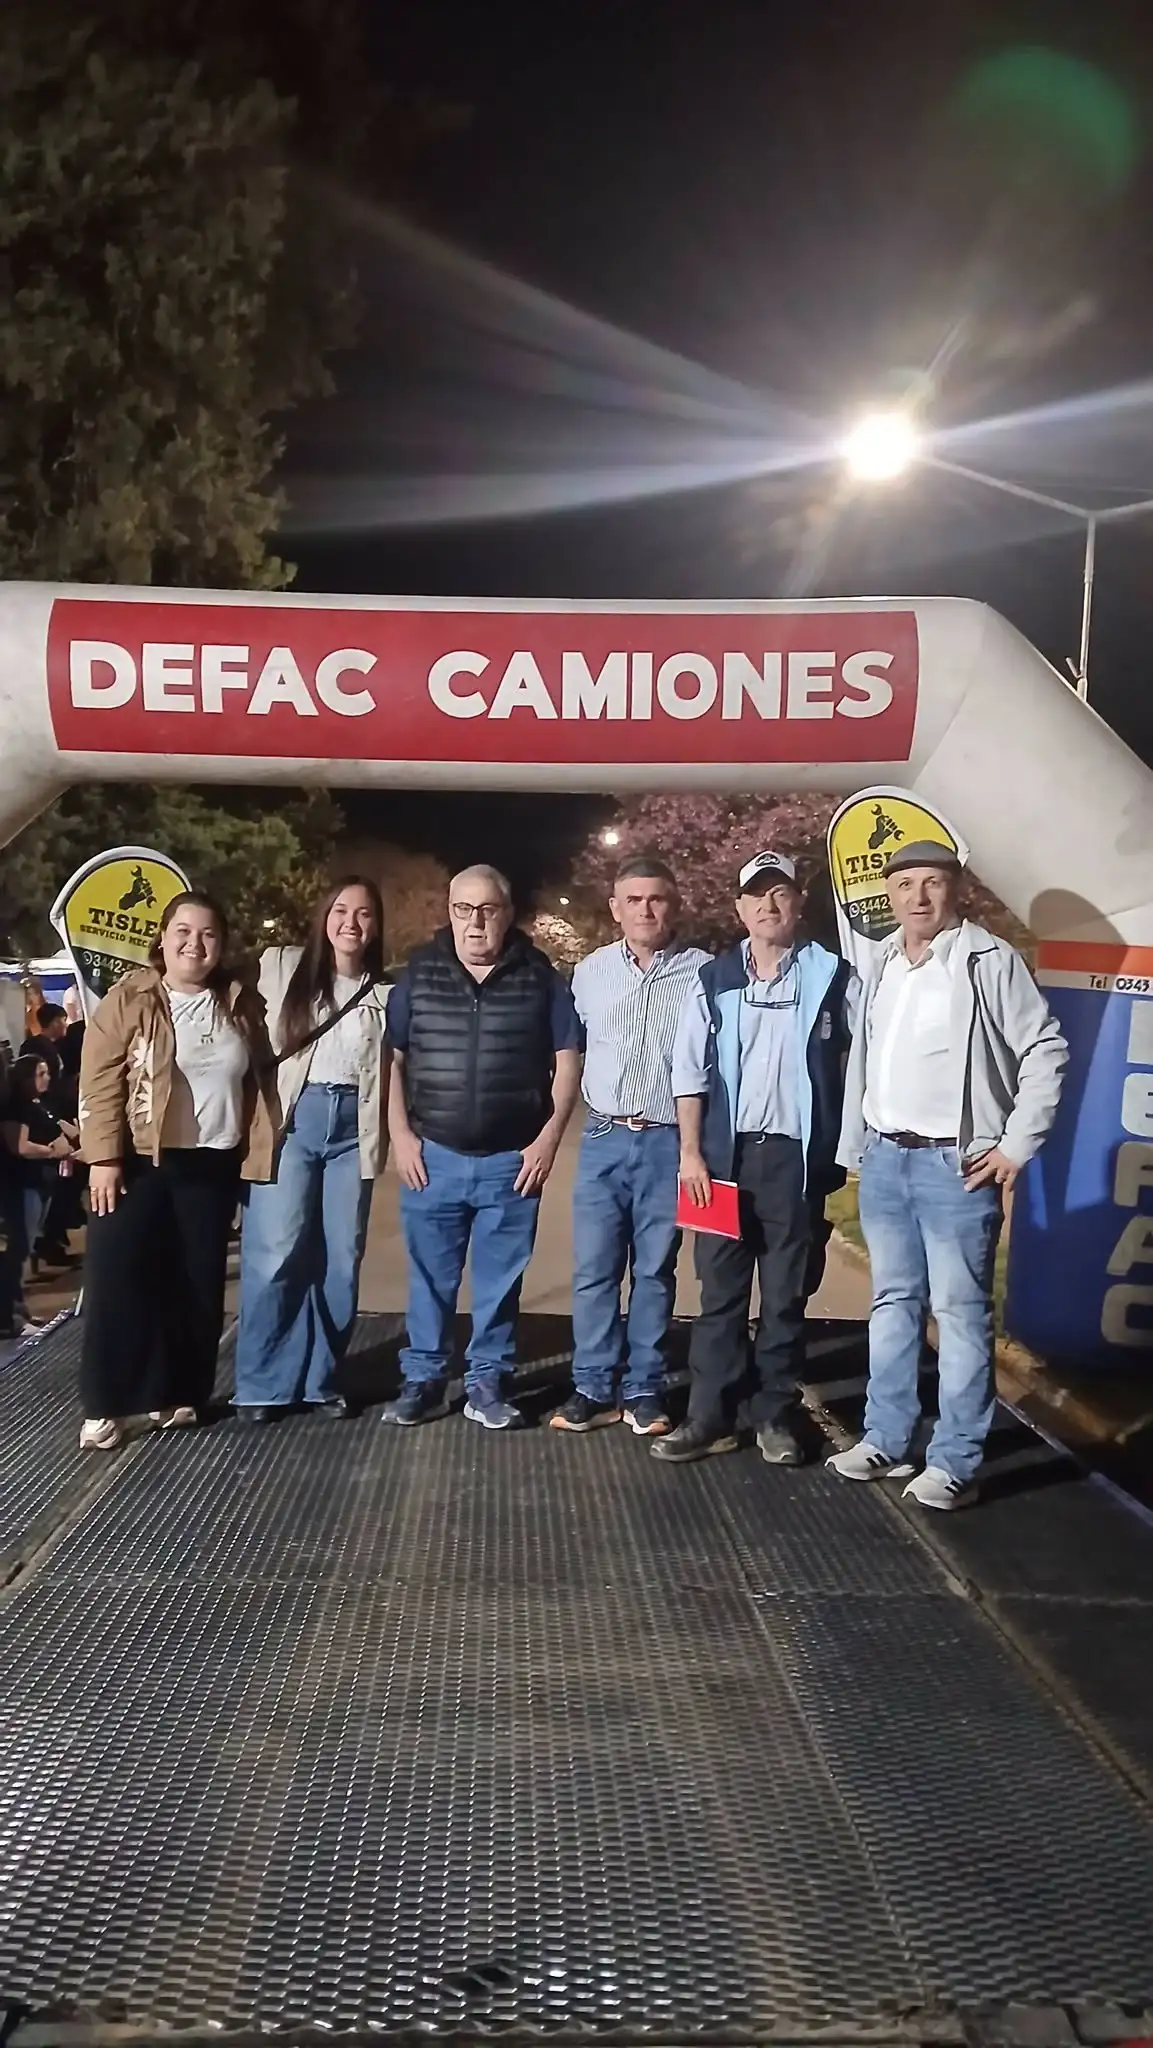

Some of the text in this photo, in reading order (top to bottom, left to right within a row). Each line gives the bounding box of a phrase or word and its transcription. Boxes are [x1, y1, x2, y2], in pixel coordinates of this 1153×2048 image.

[69, 640, 894, 720] DEFAC CAMIONES
[80, 924, 150, 948] SERVICIO MEC
